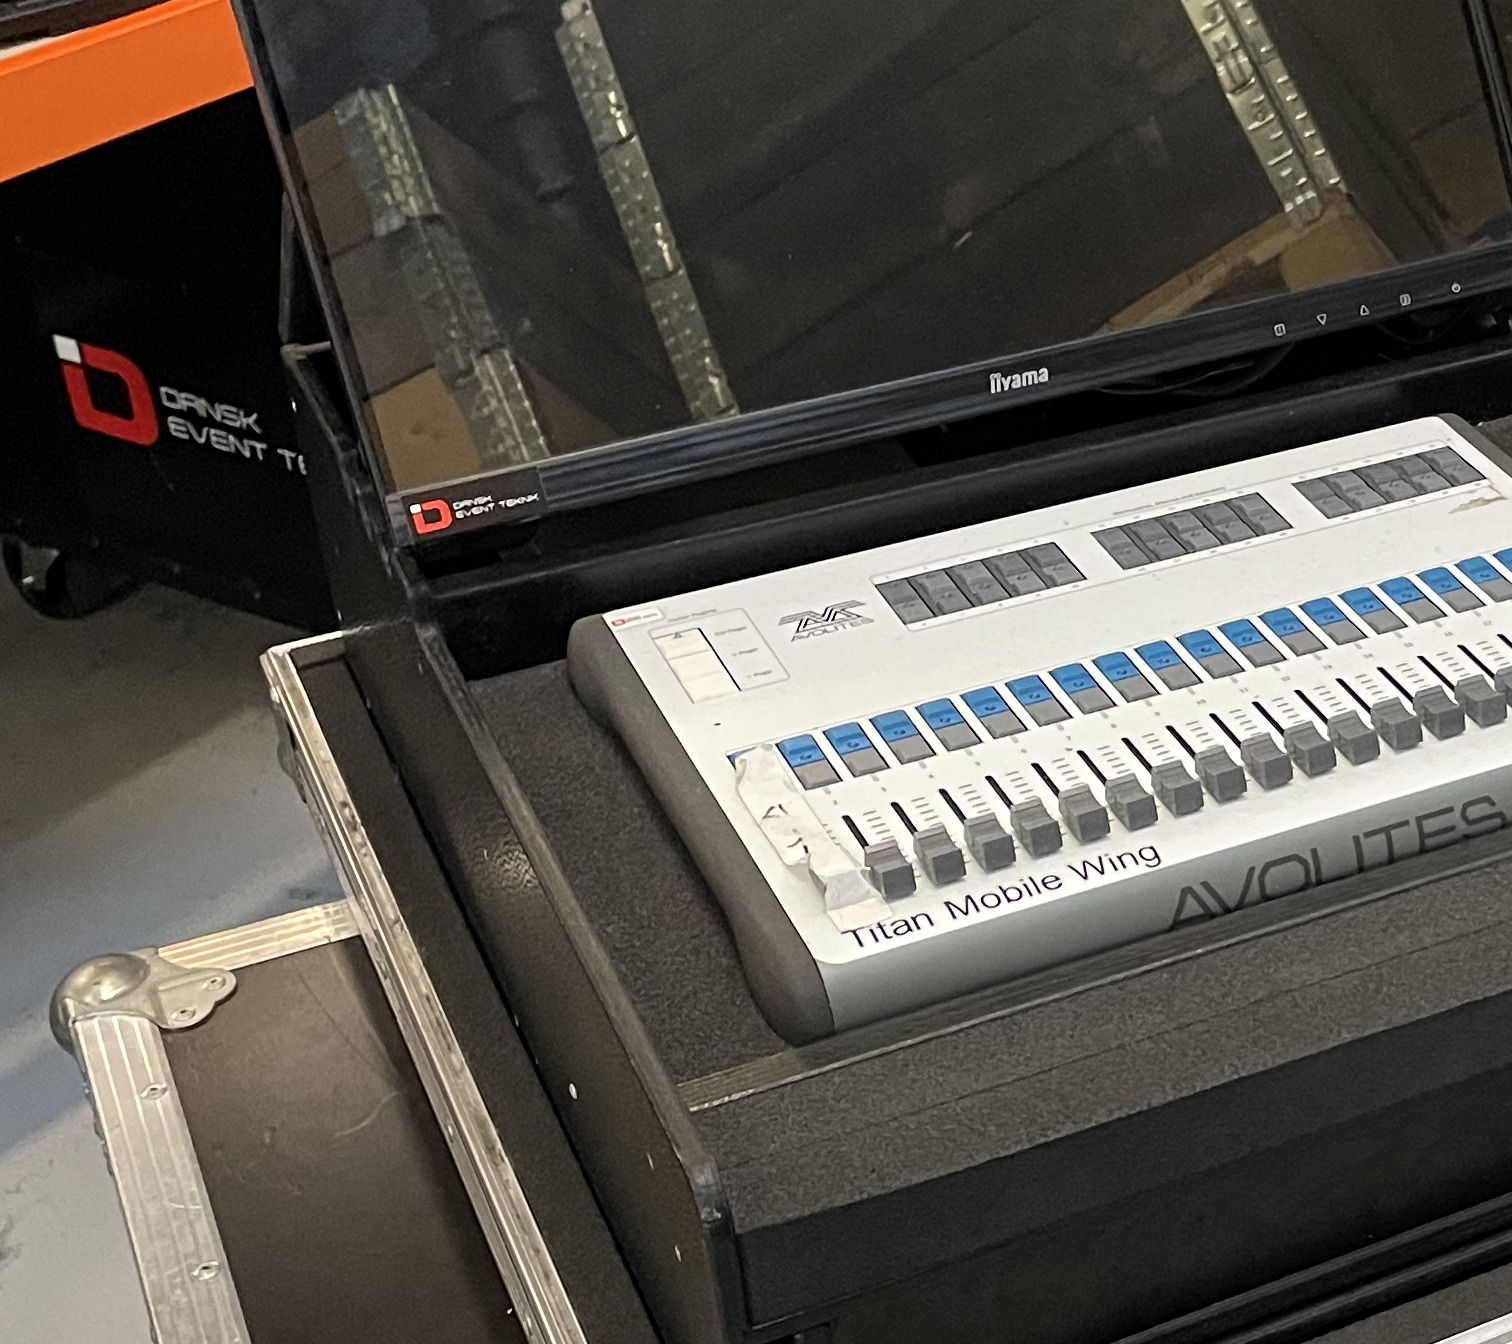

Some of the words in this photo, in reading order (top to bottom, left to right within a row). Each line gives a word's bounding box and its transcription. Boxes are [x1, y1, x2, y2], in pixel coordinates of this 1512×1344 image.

[159, 385, 263, 434] DANSK
[167, 415, 268, 462] EVENT
[844, 909, 935, 949] Titan
[944, 872, 1064, 920] Mobile
[1067, 844, 1162, 881] Wing
